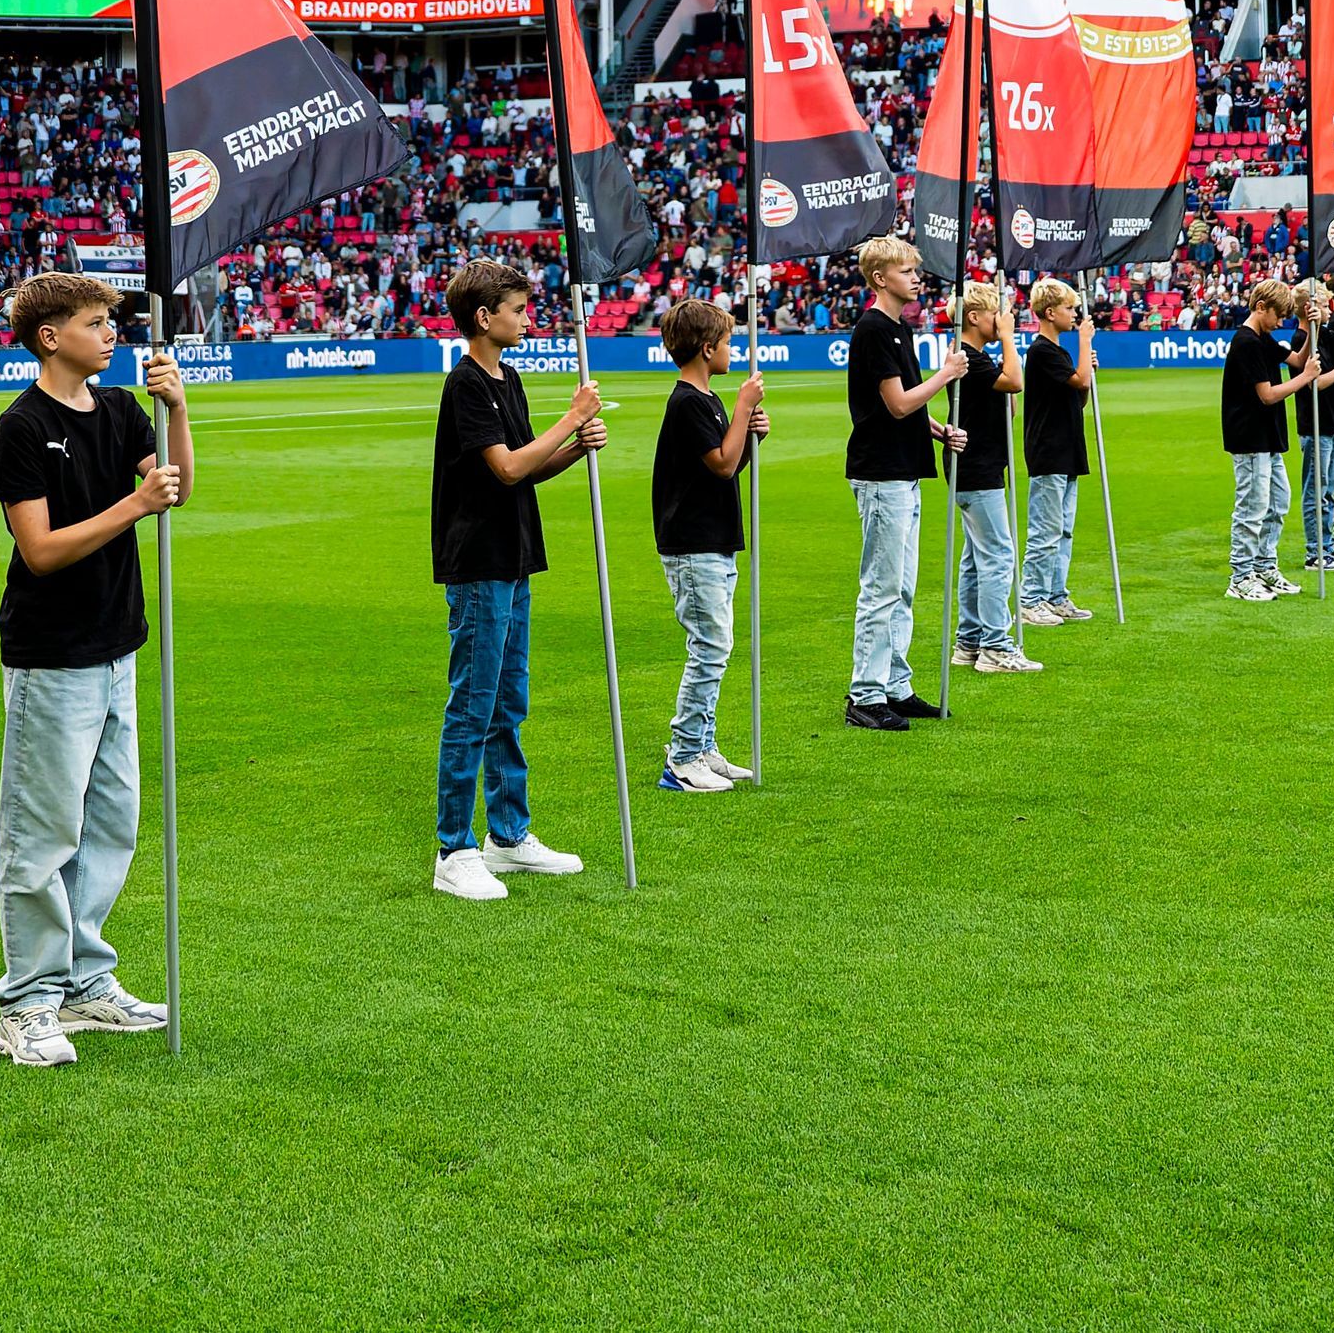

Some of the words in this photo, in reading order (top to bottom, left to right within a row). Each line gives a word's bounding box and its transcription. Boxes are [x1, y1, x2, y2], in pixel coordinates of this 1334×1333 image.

[301, 0, 418, 19] BRAINPORT
[762, 7, 833, 73] 15x
[1104, 33, 1132, 54] EST
[1135, 35, 1169, 54] 1913
[1000, 81, 1056, 131] 26x
[234, 128, 302, 173] MAAKT
[801, 172, 882, 198] EENDRACHT
[764, 196, 779, 207] PSV
[806, 190, 858, 210] MAAKT
[1109, 228, 1141, 237] MAAKT
[179, 345, 223, 361] HOTELS
[224, 345, 233, 361] &
[286, 346, 376, 370] nh-hotels.com
[180, 366, 234, 383] RESORTS
